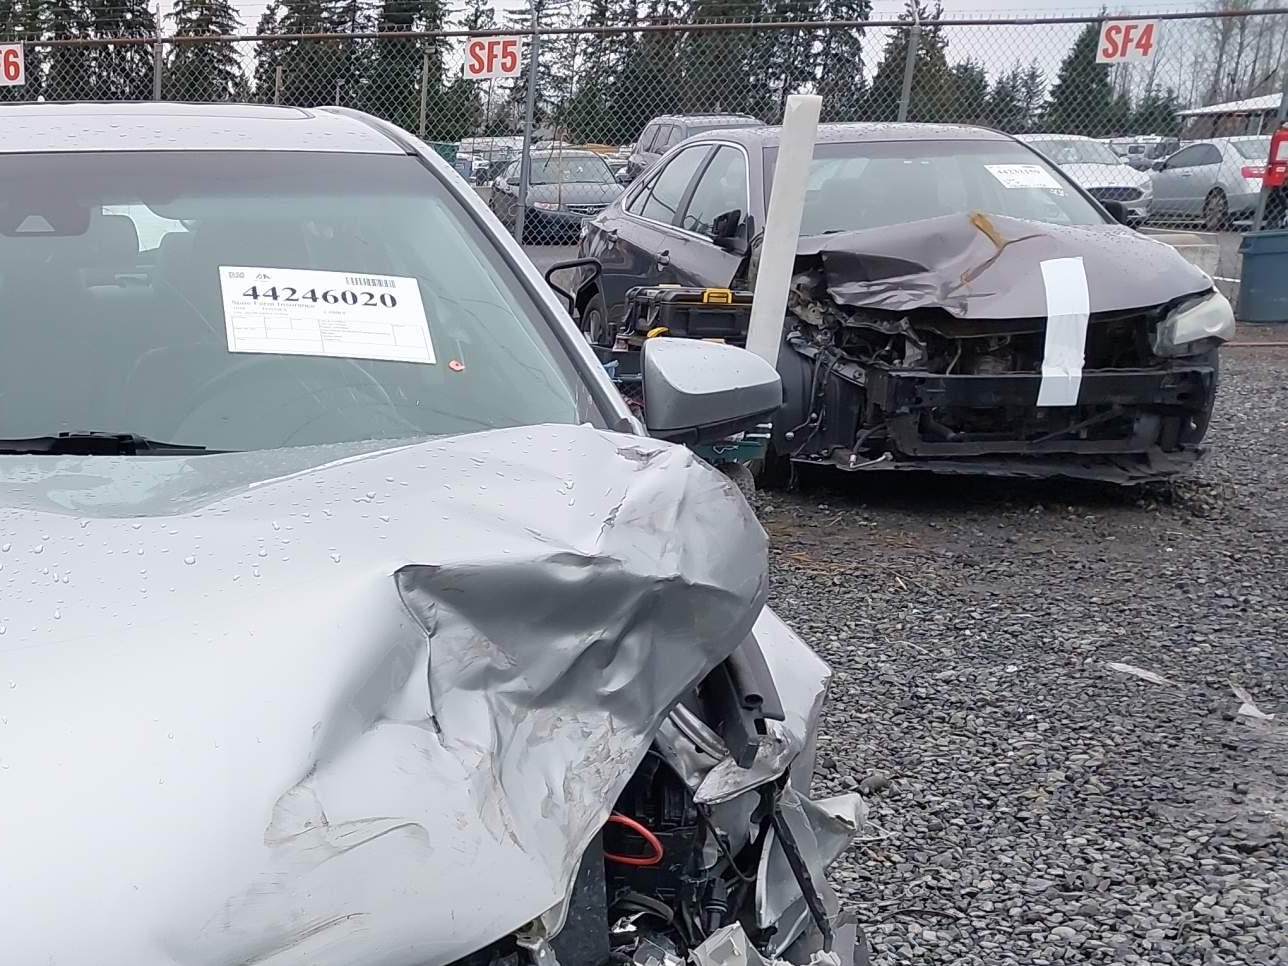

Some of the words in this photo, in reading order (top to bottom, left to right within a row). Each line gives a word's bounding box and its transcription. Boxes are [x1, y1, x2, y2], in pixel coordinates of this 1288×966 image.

[469, 40, 517, 74] SF5
[1102, 23, 1154, 58] SF4
[242, 285, 397, 308] 44246020
